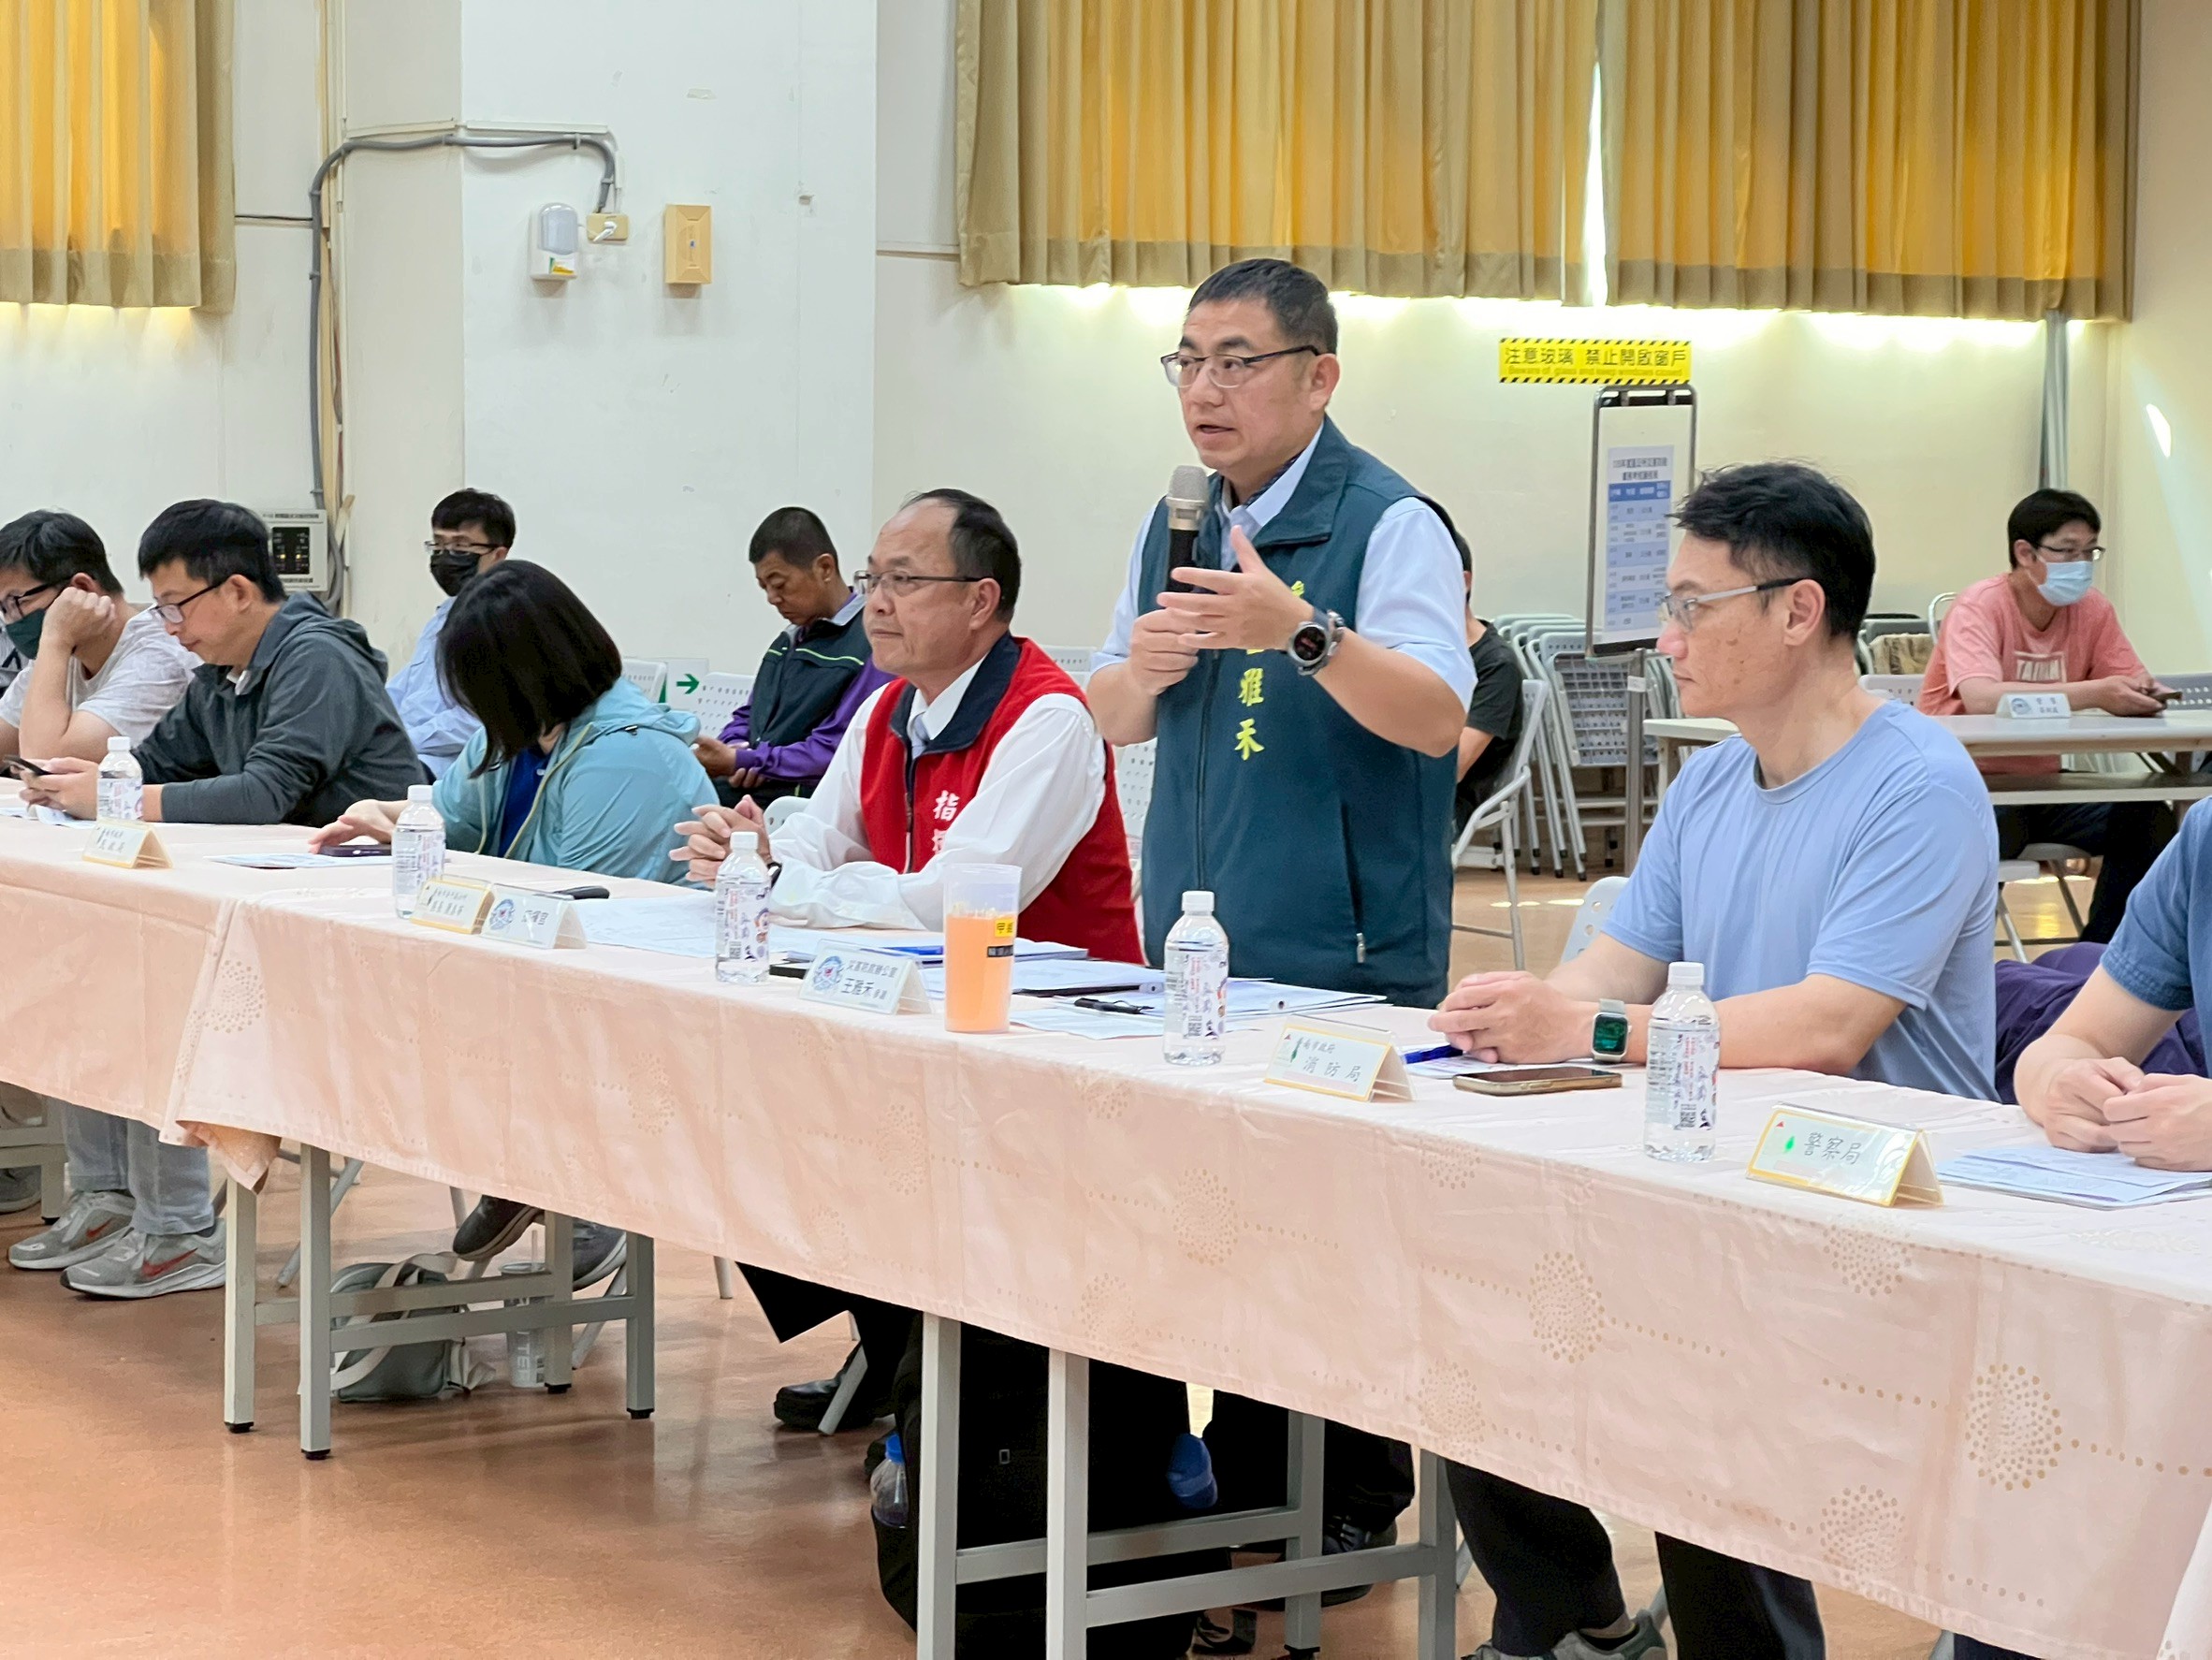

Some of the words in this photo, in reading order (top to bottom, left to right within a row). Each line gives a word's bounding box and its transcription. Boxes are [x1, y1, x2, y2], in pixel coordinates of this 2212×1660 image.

[1505, 347, 1574, 365] 注意玻璃
[1585, 348, 1686, 367] 禁止開啟窗戶
[1234, 648, 1264, 761] 雅禾
[1302, 1056, 1362, 1082] 消防局
[1804, 1132, 1862, 1165] 警察局
